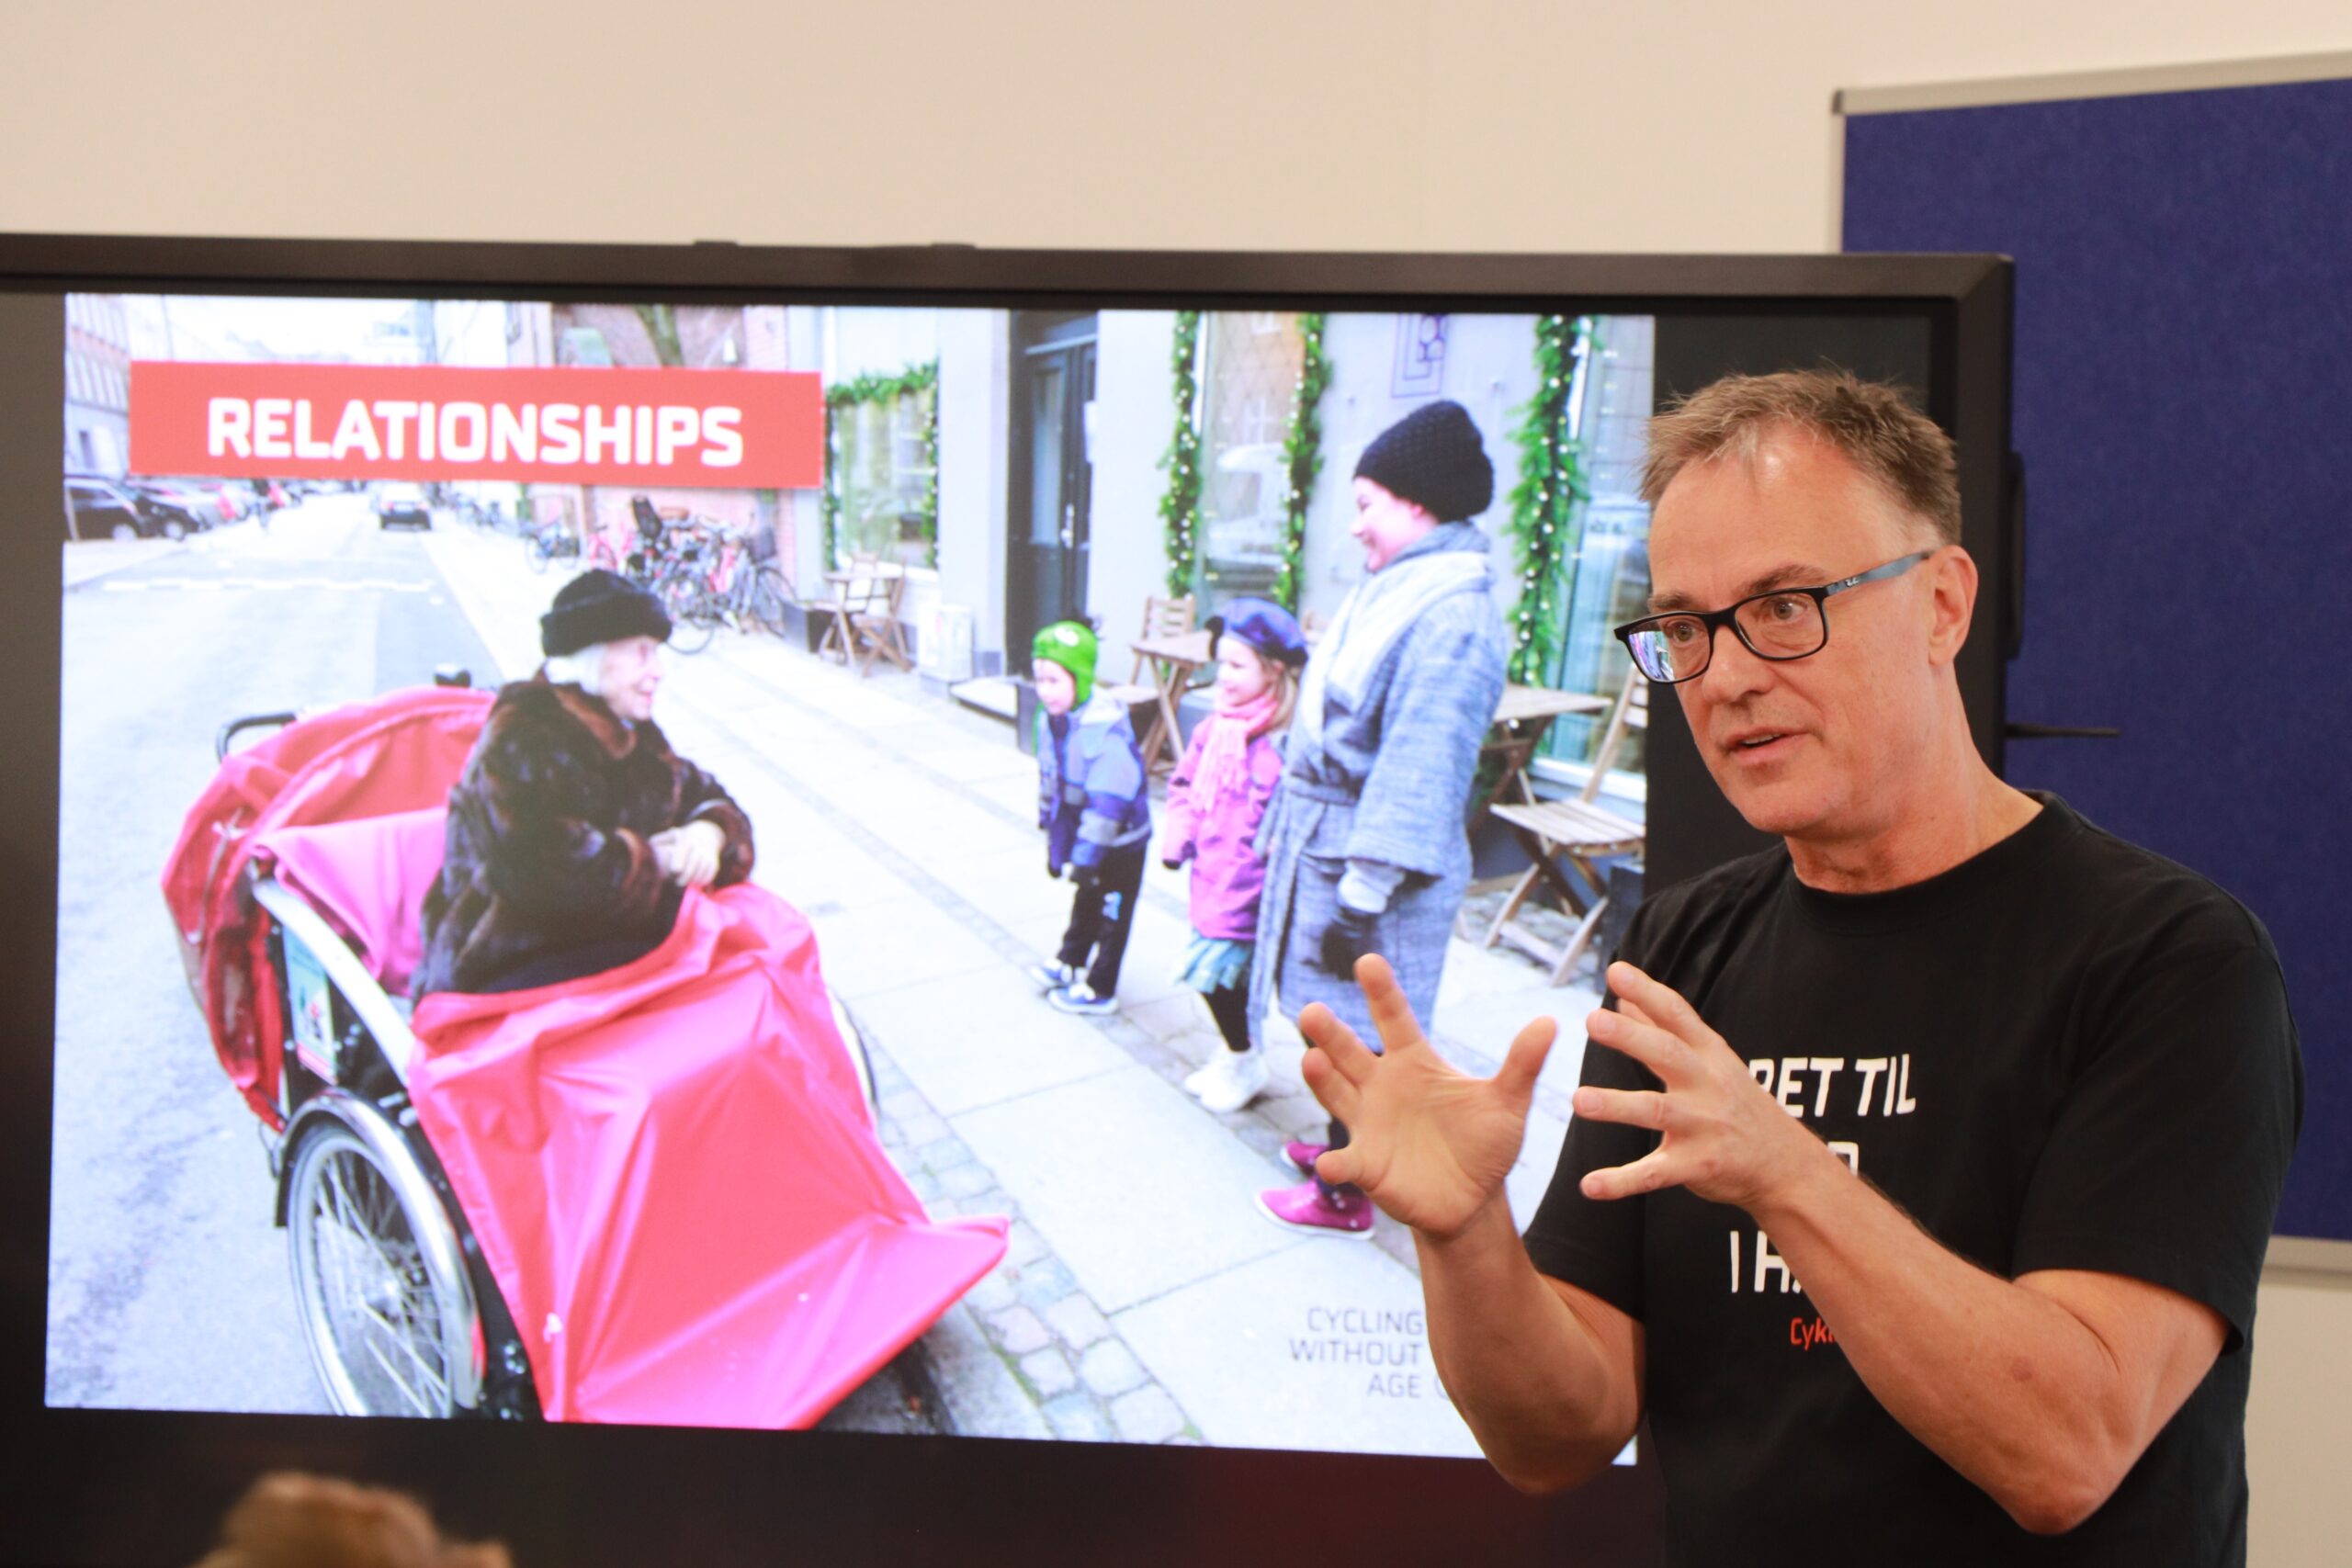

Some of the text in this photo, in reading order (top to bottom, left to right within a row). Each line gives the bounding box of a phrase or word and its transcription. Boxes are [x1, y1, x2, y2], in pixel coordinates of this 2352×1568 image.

[208, 397, 743, 467] RELATIONSHIPS
[1854, 1053, 1917, 1118] TIL
[1754, 1230, 1801, 1293] H
[1307, 1307, 1423, 1335] CYCLING
[1290, 1338, 1421, 1366] WITHOUT
[1366, 1373, 1421, 1398] AGE
